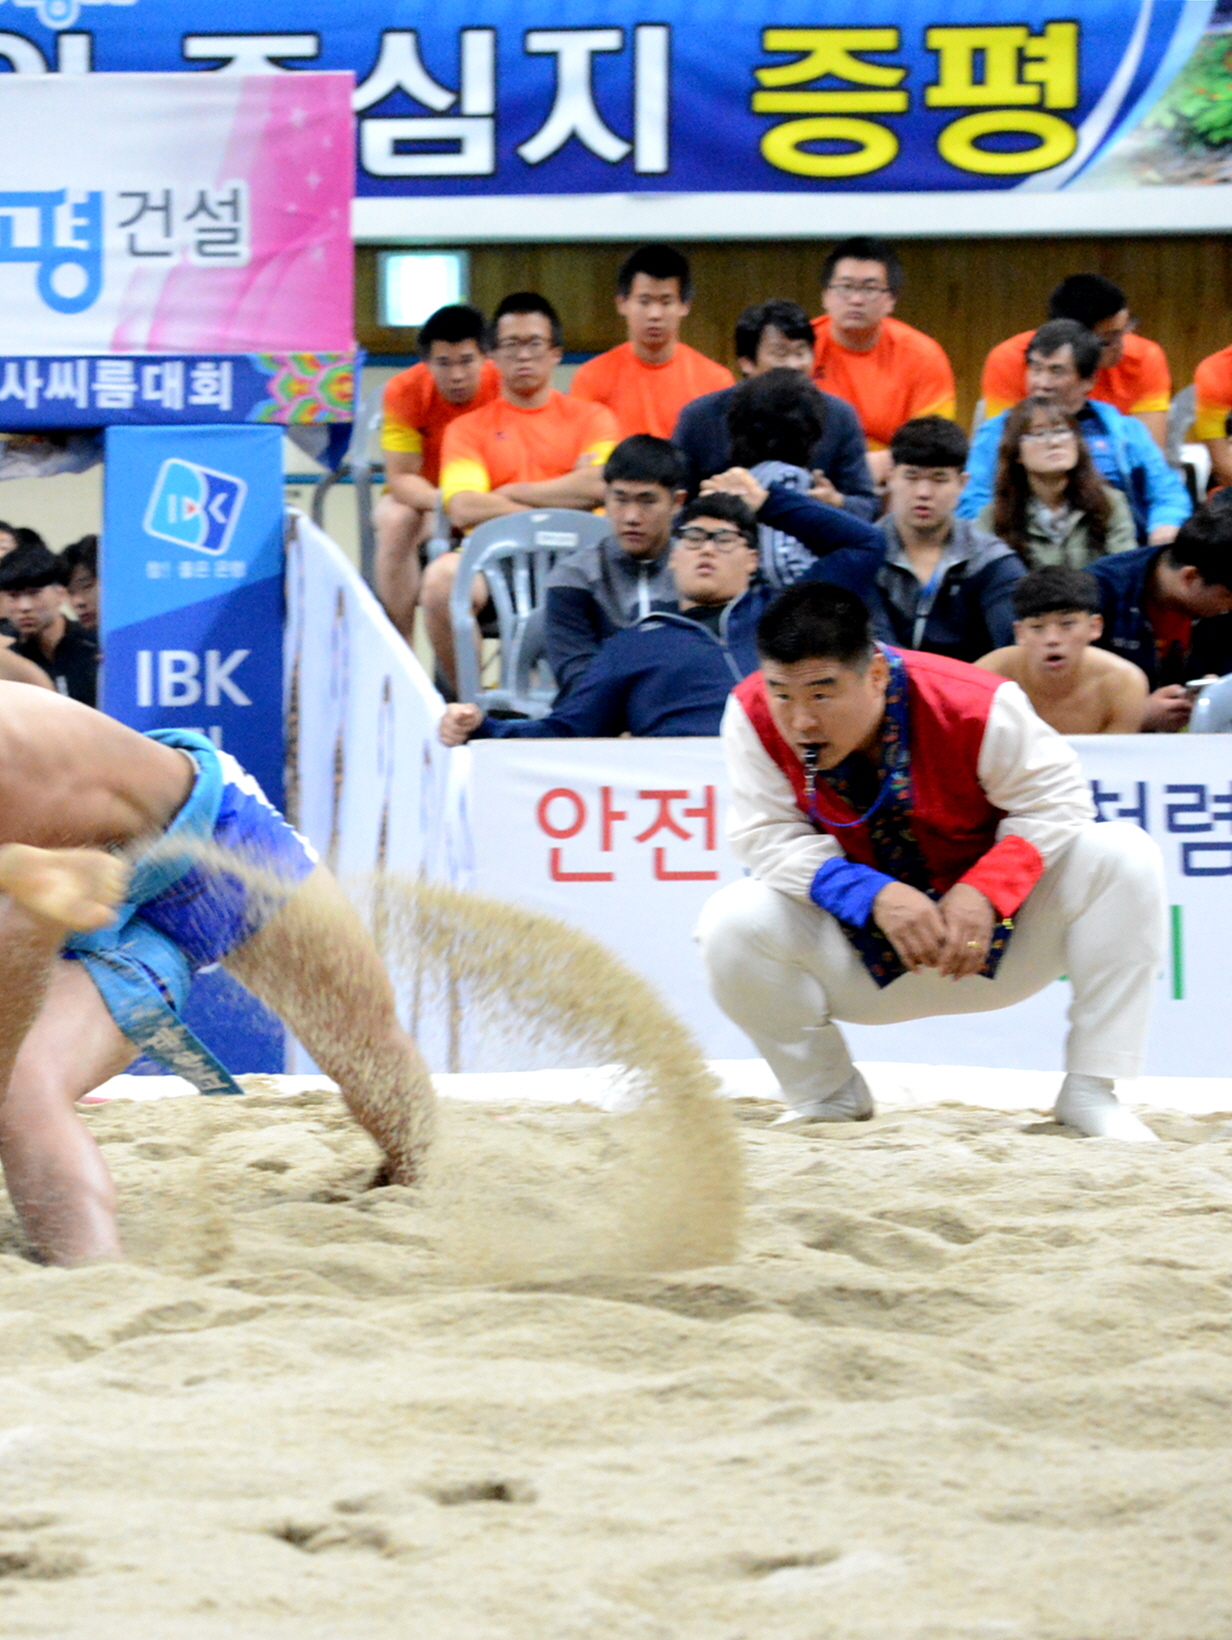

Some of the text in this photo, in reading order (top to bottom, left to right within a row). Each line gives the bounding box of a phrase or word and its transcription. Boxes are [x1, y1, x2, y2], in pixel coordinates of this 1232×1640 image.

[751, 21, 1079, 178] 증평
[117, 188, 241, 258] 건설
[136, 649, 253, 708] IBK
[536, 784, 720, 882] 안전
